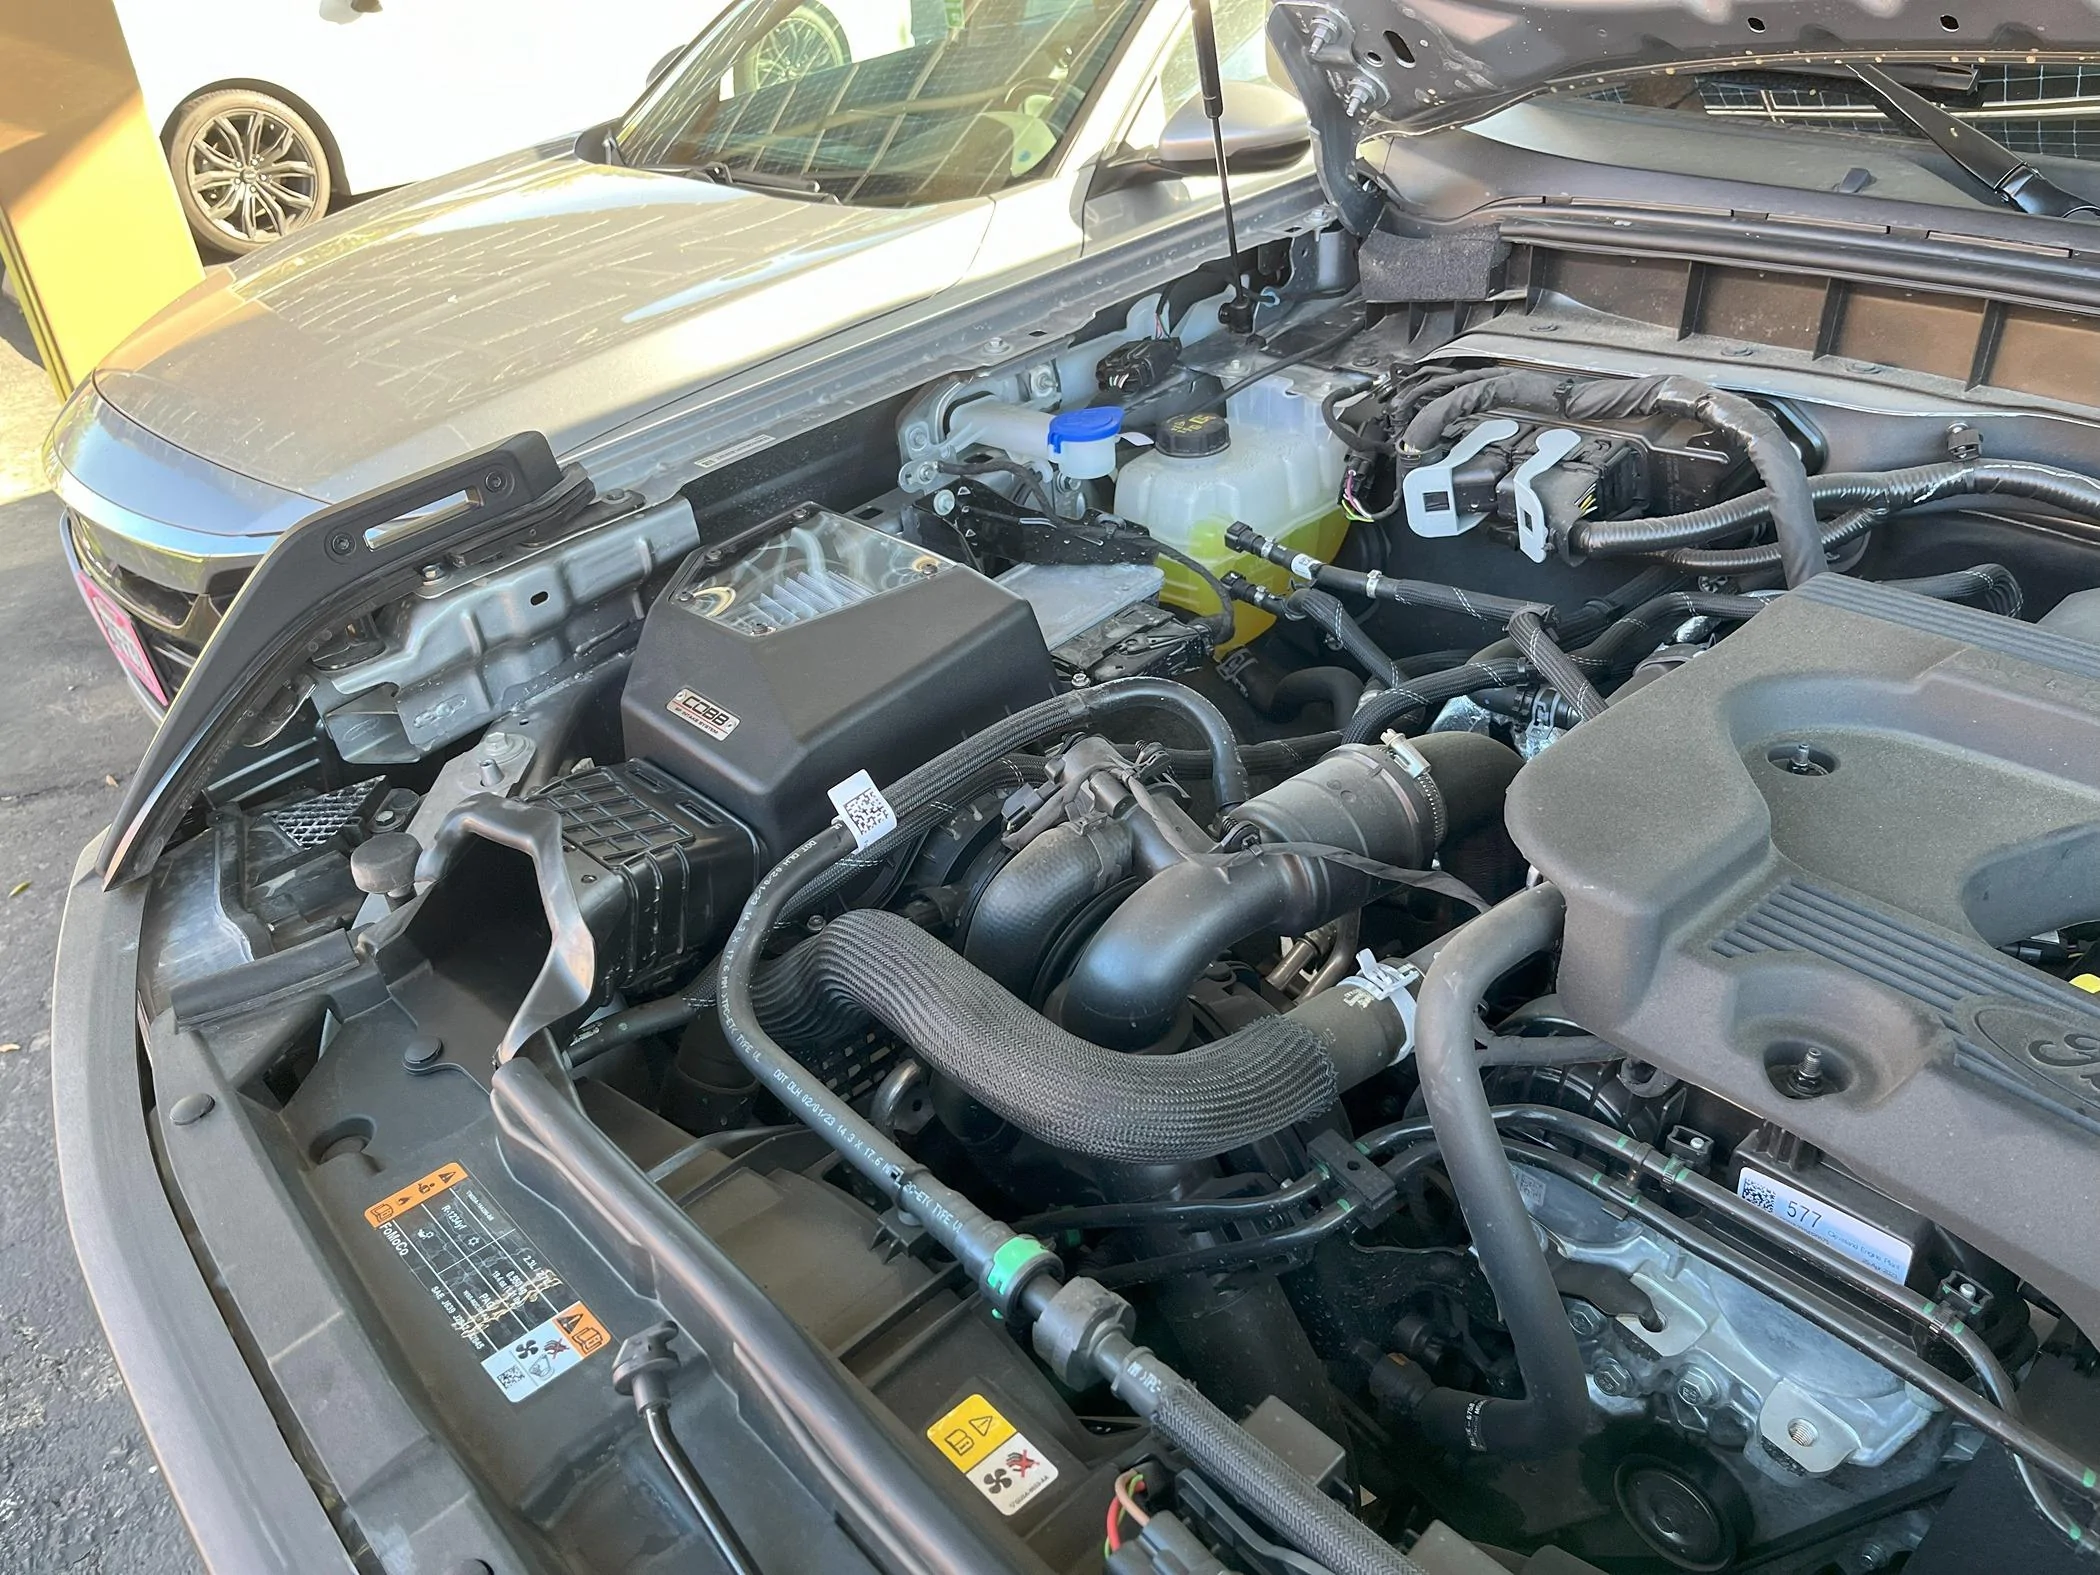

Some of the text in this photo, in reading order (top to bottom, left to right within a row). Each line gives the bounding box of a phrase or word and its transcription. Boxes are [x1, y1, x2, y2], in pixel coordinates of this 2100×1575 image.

[682, 696, 729, 726] COBB
[699, 721, 719, 734] SYSTEM
[801, 1094, 836, 1126] 02/01/23
[837, 1124, 855, 1143] 14.3
[854, 1139, 864, 1149] X
[864, 1147, 884, 1166] 17.6
[932, 1202, 954, 1225] TYPE
[441, 1204, 467, 1230] R-1234yf
[1786, 1200, 1822, 1228] 577
[379, 1222, 409, 1256] FoMoCo
[523, 1253, 538, 1269] 2.3L
[430, 1285, 444, 1299] SAE
